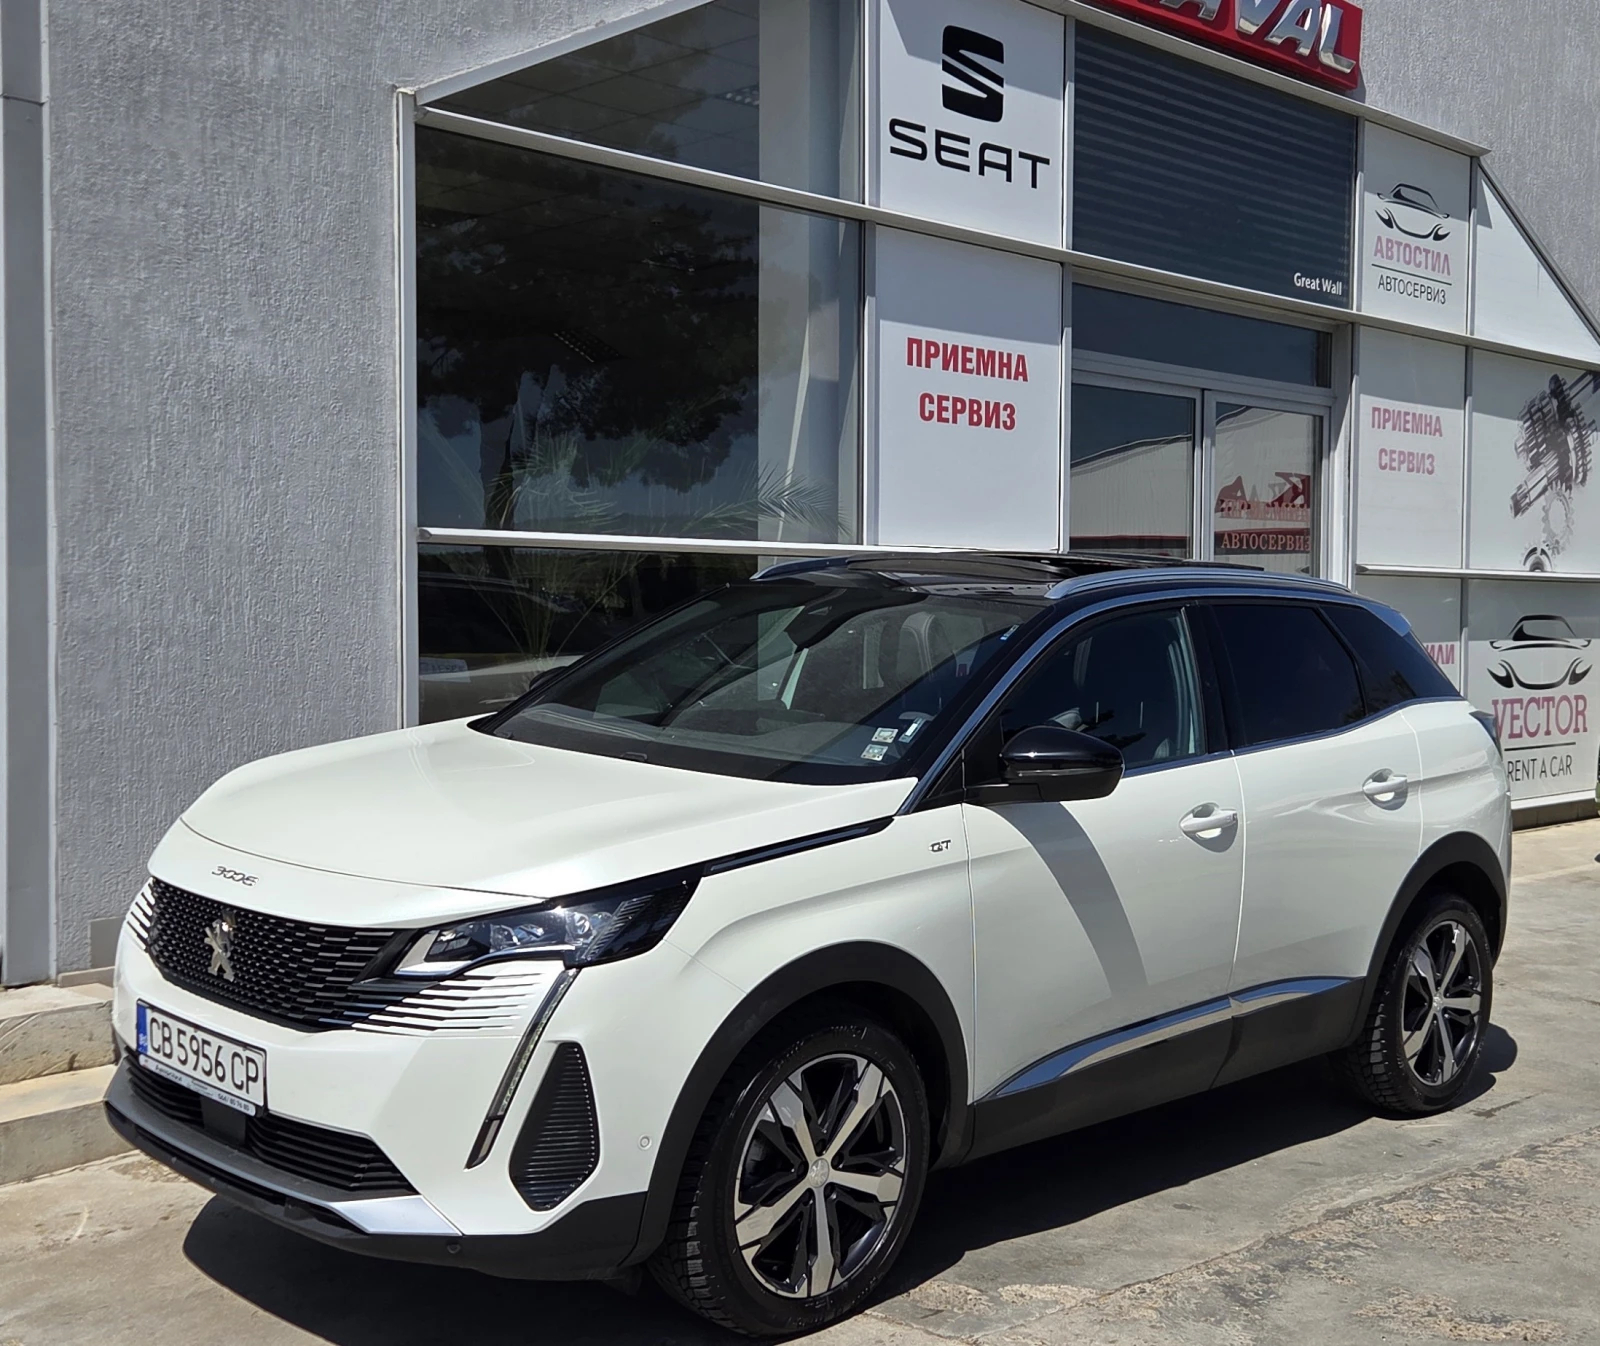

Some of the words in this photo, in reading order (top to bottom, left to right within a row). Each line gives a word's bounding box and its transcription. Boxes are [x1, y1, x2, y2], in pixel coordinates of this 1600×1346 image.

[889, 118, 1050, 189] SEAT
[1373, 235, 1451, 276] АВТОСТИЛ
[1293, 272, 1320, 291] Great
[1321, 278, 1342, 296] Wall
[1377, 274, 1446, 305] АВТОСЕРВИЗ
[906, 336, 1029, 382] ПРИЕМНА
[919, 392, 1016, 431] СЕРВИЗ
[1371, 406, 1443, 437] ПРИЕМНА
[1378, 447, 1435, 475] СЕРВИЗ
[1221, 532, 1311, 551] АВТОСЕРВИЗ
[1492, 694, 1588, 739] VECTOR
[1507, 758, 1538, 782] RENT
[1539, 757, 1548, 779] A
[1550, 754, 1573, 777] CAR
[930, 839, 951, 853] GT
